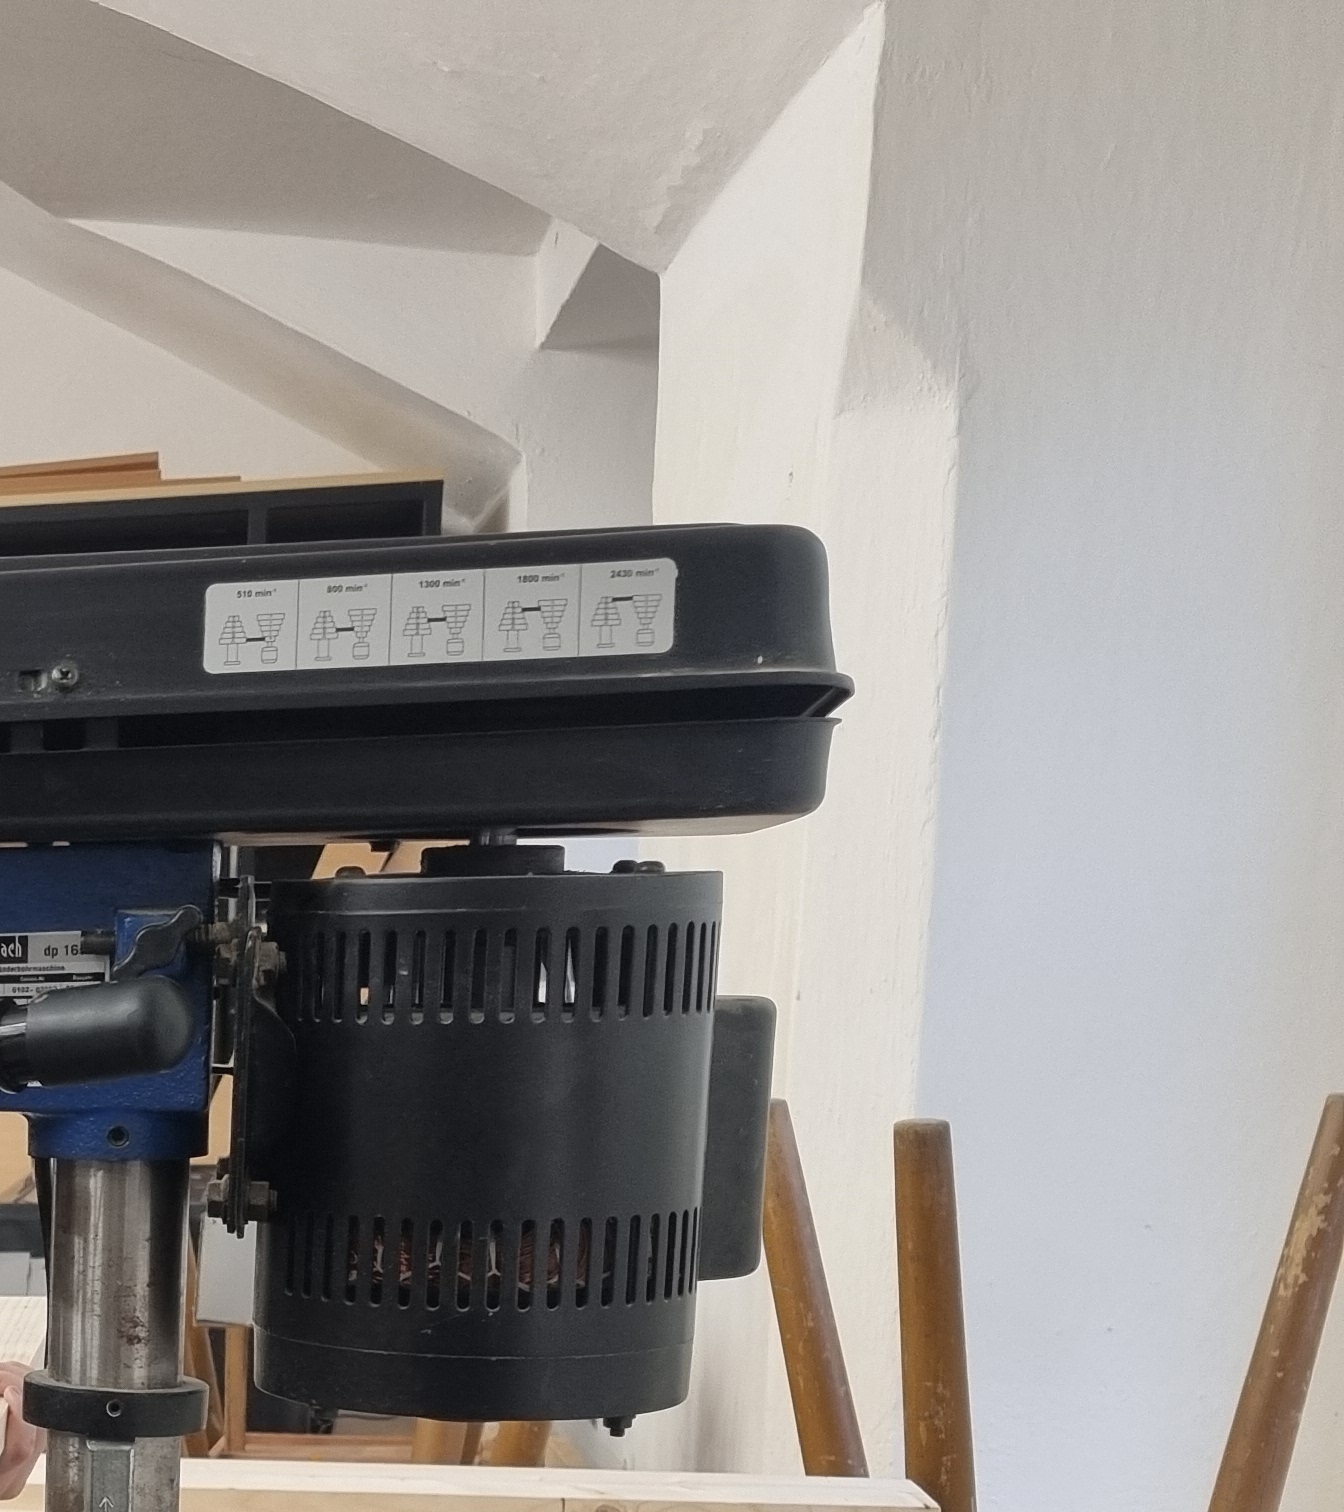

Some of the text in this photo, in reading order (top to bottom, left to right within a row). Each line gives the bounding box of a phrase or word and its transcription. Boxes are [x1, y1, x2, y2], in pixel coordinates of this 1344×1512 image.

[516, 574, 539, 583] 1800
[609, 569, 632, 579] 2430
[418, 579, 440, 588] 1300
[326, 584, 343, 594] 800
[236, 590, 252, 599] 510
[43, 943, 84, 959] dp 16
